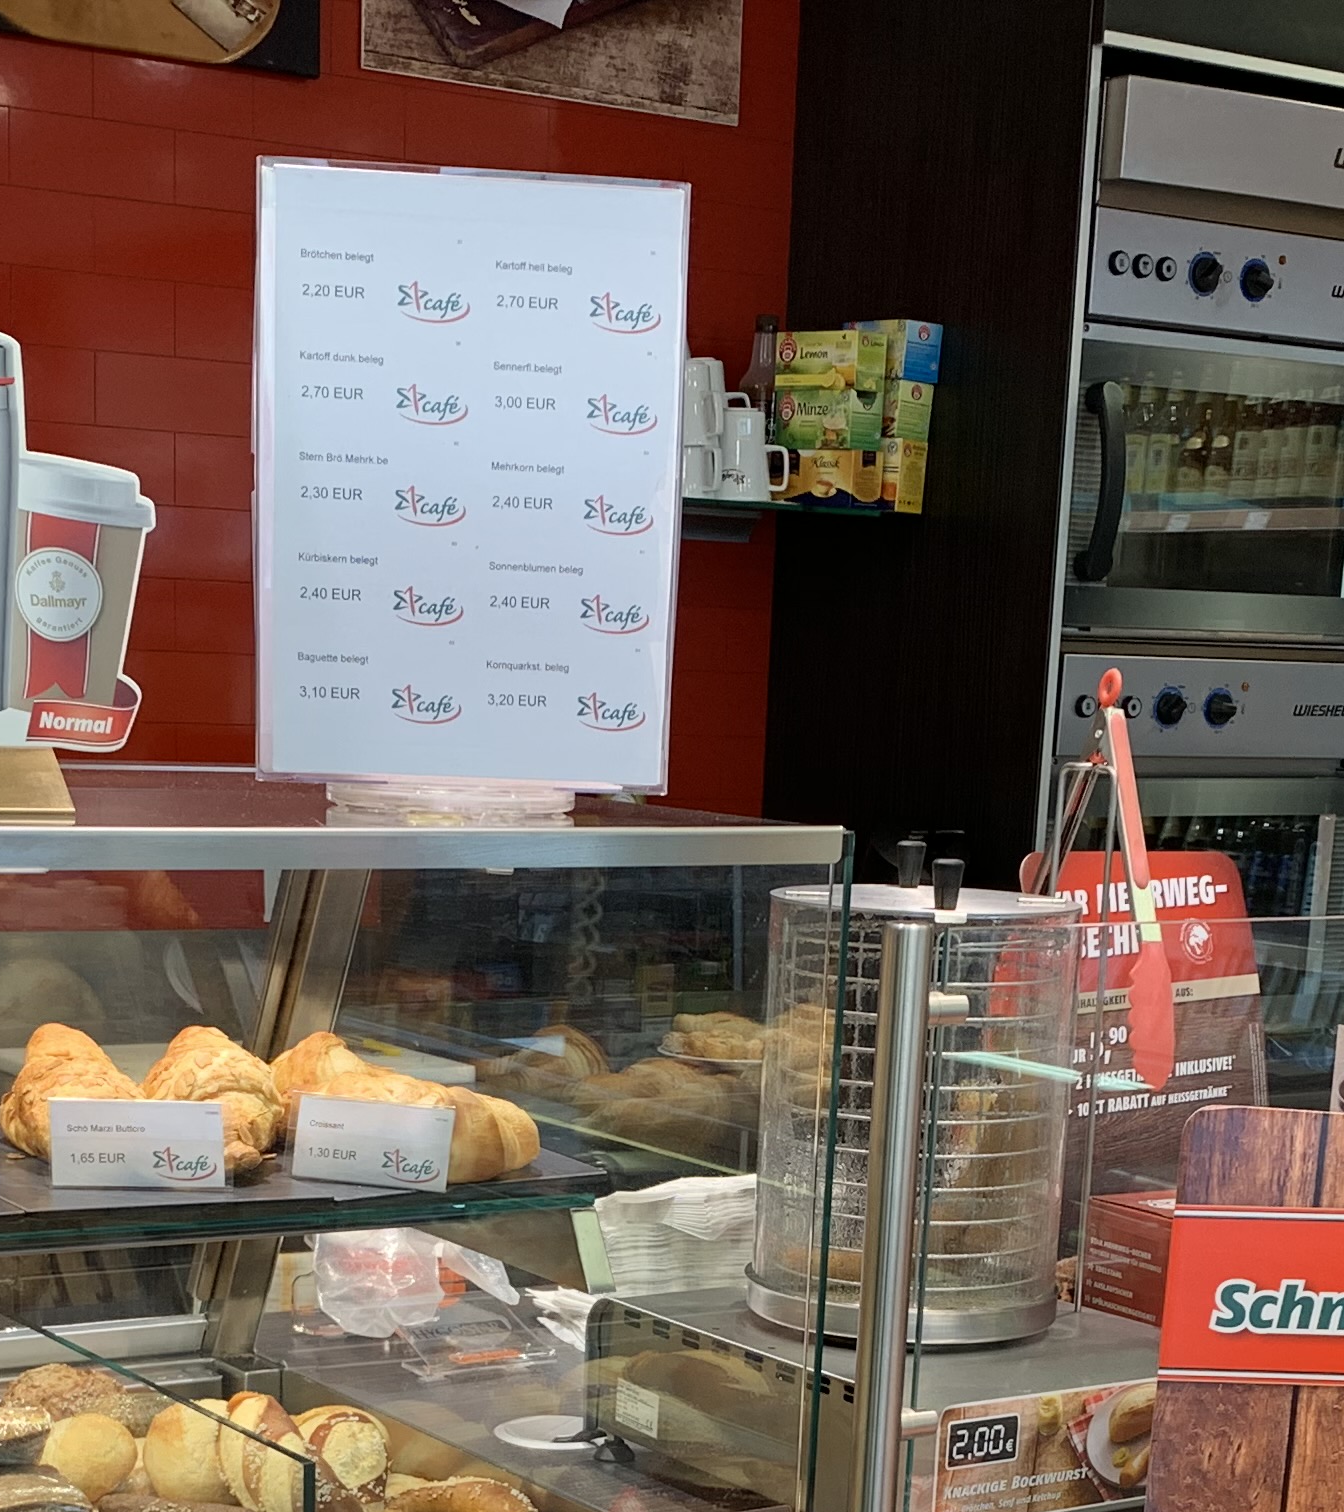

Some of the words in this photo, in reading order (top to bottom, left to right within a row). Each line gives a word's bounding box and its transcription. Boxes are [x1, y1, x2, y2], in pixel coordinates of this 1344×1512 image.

[300, 248, 342, 261] Brötchen
[344, 251, 374, 264] belegt
[302, 284, 330, 300] 2,20
[334, 285, 365, 299] EUR
[496, 295, 525, 311] 2,70
[528, 296, 558, 311] EUR
[800, 347, 828, 360] Lemon
[301, 386, 330, 401] 2,70
[333, 387, 364, 400] EUR
[495, 396, 523, 411] 3,00
[526, 396, 556, 411] EUR
[797, 402, 829, 416] Minze
[491, 462, 534, 474] Mehrkorn
[536, 463, 565, 476] belegt
[300, 486, 329, 501] 2,30
[332, 487, 363, 501] EUR
[492, 495, 520, 510] 2,40
[523, 496, 553, 510] EUR
[298, 552, 348, 565] Kürbiskern
[349, 554, 378, 567] belegt
[489, 561, 557, 575] Sonnenblumen
[558, 564, 584, 577] beleg
[300, 586, 328, 601] 2,40
[331, 588, 362, 601] EUR
[30, 594, 87, 609] Dallmayr
[490, 595, 517, 609] 2,40
[521, 596, 550, 609] EUR
[297, 651, 339, 665] Baguette
[340, 653, 369, 666] belegt
[299, 685, 327, 700] 3,10
[330, 687, 360, 700] EUR
[487, 694, 515, 708] 3,20
[518, 695, 547, 708] EUR
[39, 713, 113, 735] Normal
[1108, 1093, 1150, 1113] RABATT
[1150, 1096, 1167, 1106] AUF
[310, 1119, 345, 1130] Croissant
[70, 1153, 95, 1165] 1,65
[99, 1153, 126, 1163] EUR
[308, 1147, 329, 1158] 1,30
[333, 1149, 356, 1160] EUR
[176, 1155, 209, 1177] café
[402, 1159, 434, 1179] café
[943, 1479, 1007, 1499] KNACKIGE
[1012, 1467, 1091, 1489] BOCKWURST
[1032, 1491, 1061, 1503] Ketchup
